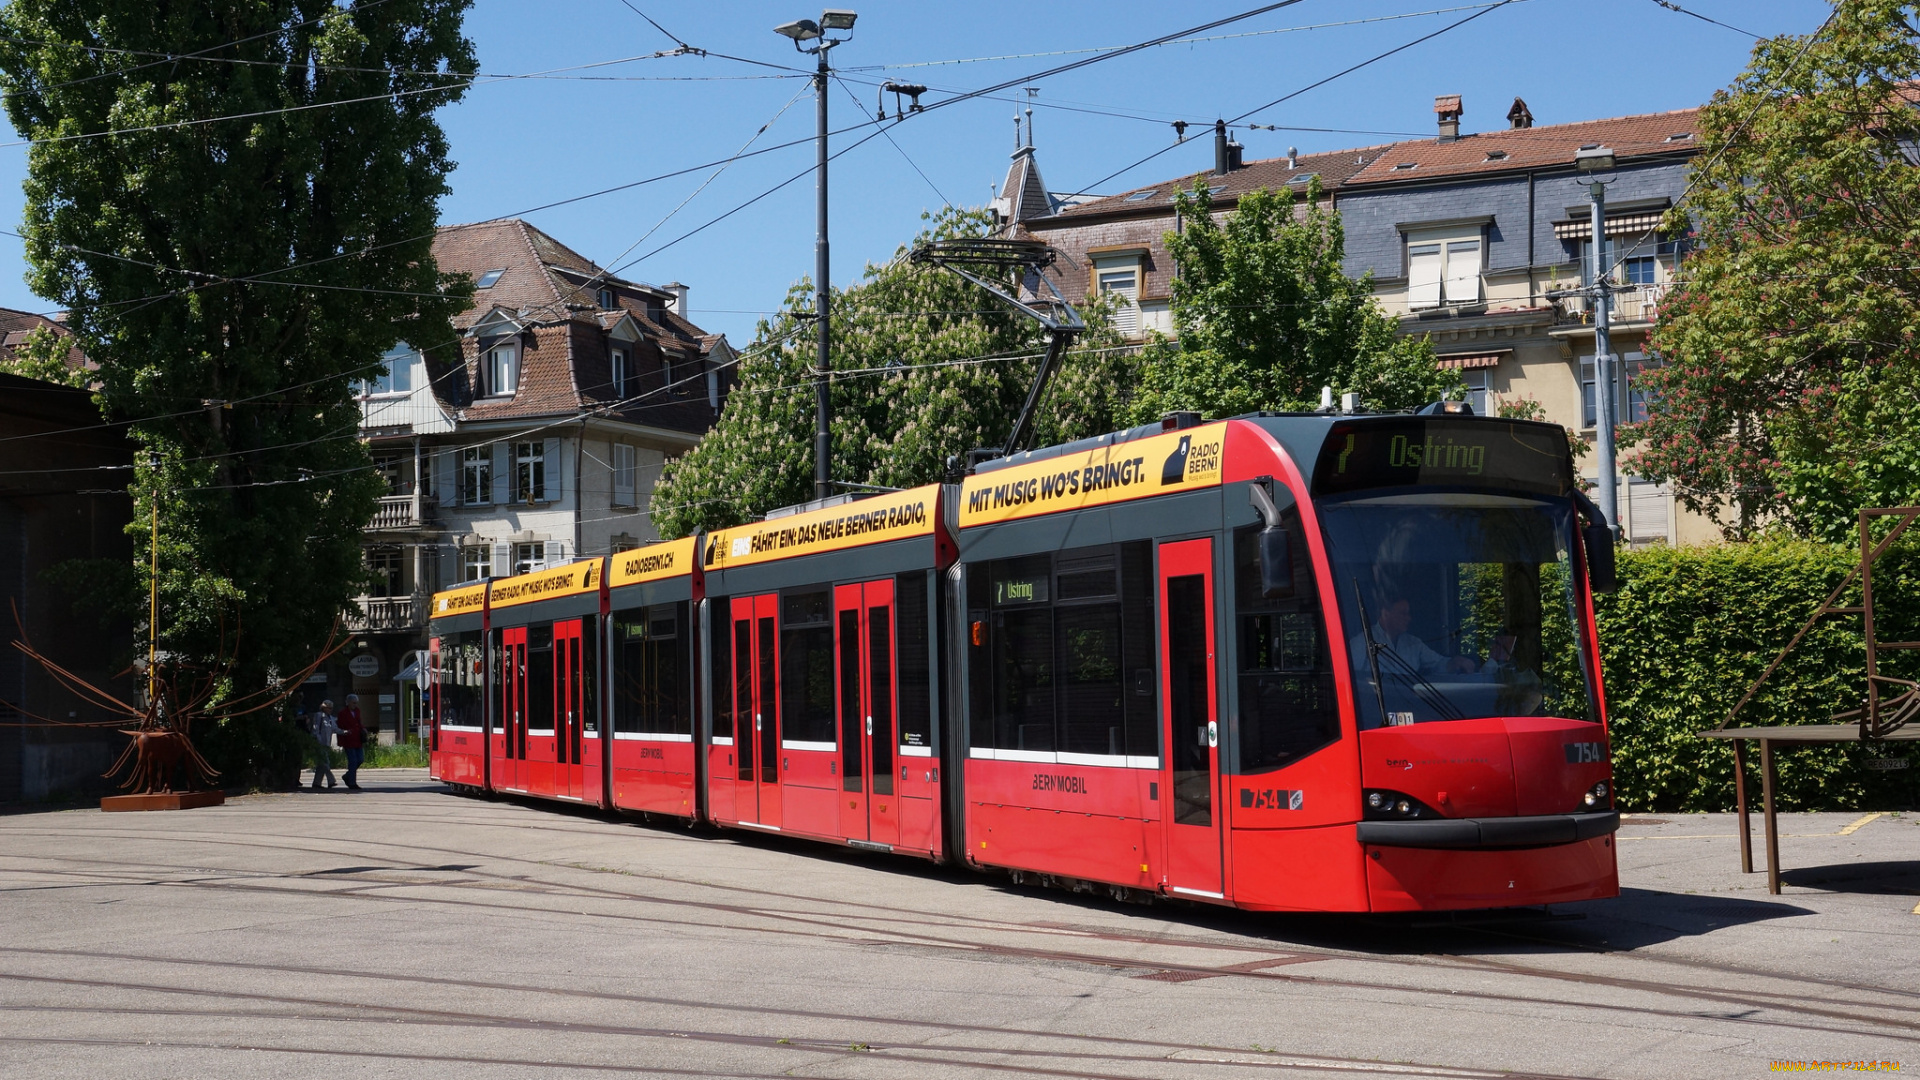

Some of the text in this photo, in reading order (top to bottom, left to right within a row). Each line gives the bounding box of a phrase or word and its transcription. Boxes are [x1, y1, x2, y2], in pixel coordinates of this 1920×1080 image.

[1190, 442, 1220, 460] RADIO
[1389, 435, 1485, 475] Ostring
[968, 487, 993, 514] MIT
[993, 478, 1038, 509] MUSIG
[1082, 456, 1145, 494] BRINGT.
[750, 530, 779, 554] FÄHRT
[779, 527, 797, 549] EIN:
[797, 523, 817, 546] DAS
[817, 517, 845, 542] NEUE
[845, 509, 887, 537] BERNER
[888, 501, 926, 529] RADIO,
[520, 582, 529, 597] MIT
[1386, 758, 1409, 767] bern
[1574, 742, 1600, 763] 754
[1249, 788, 1280, 810] 754
